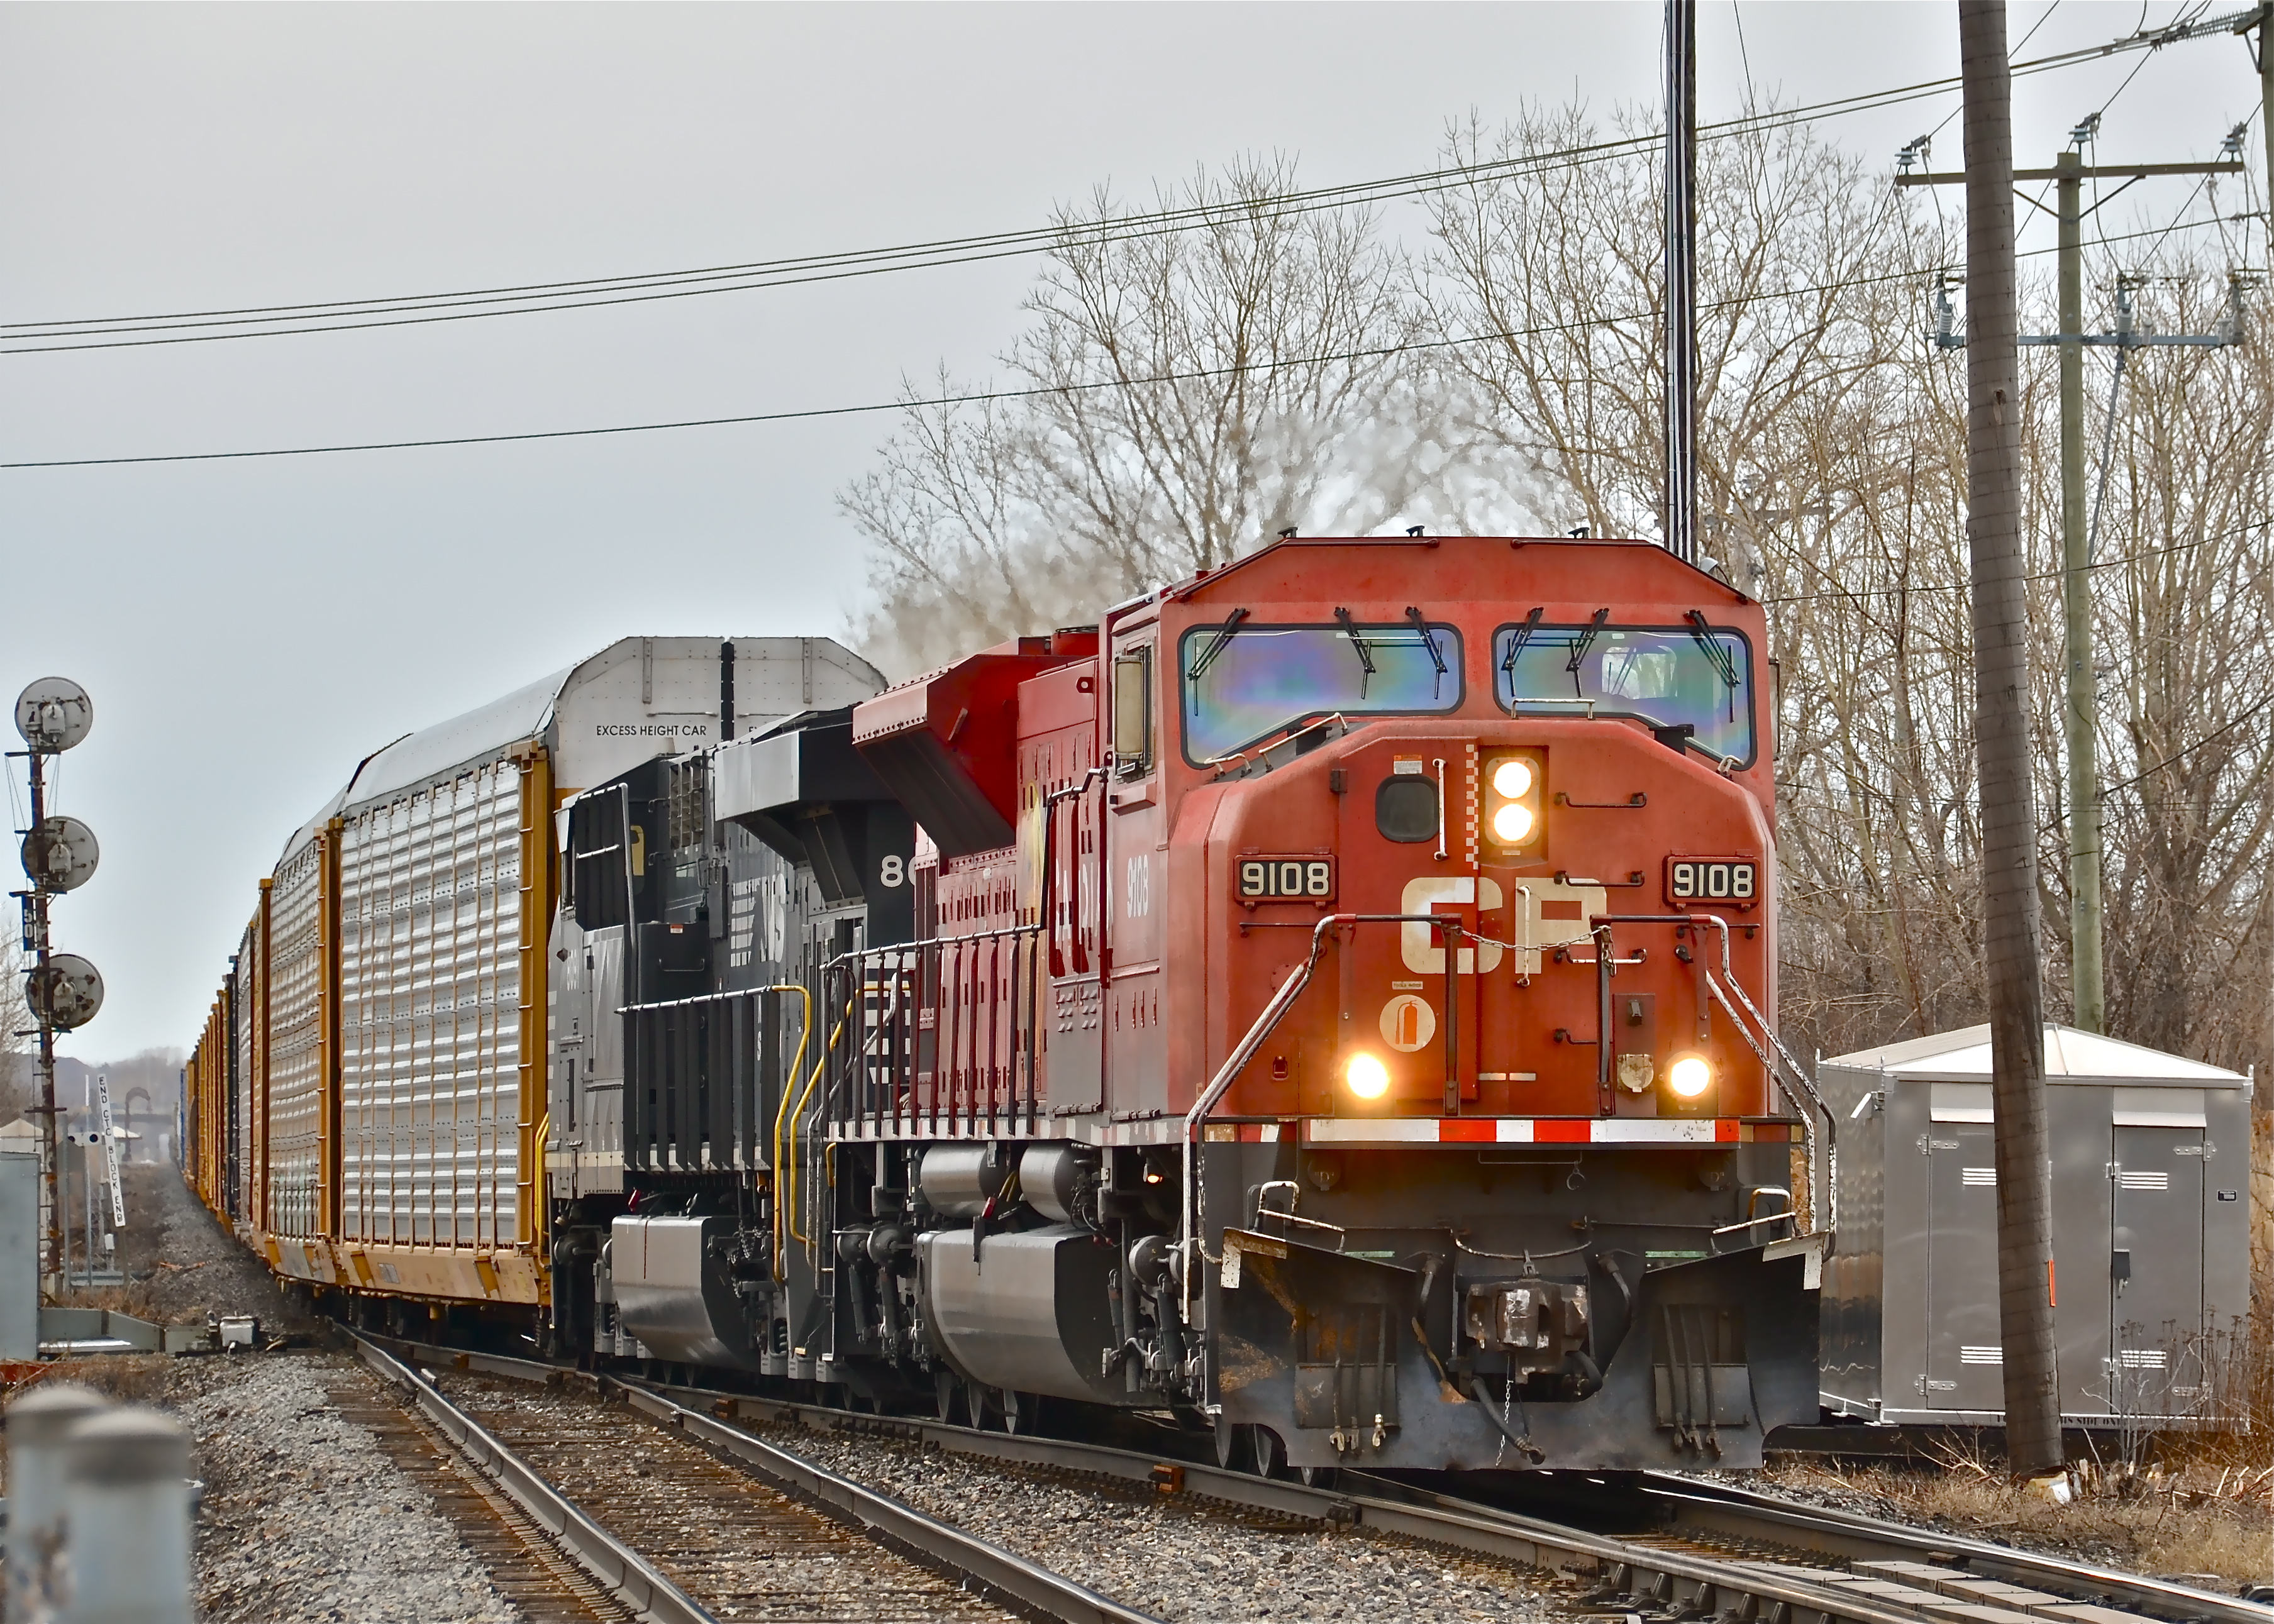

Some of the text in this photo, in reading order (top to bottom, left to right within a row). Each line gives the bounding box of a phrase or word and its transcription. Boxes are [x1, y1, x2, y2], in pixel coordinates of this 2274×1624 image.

[597, 726, 706, 736] EXCESS HEIGHT CAR
[1127, 854, 1148, 919] 9108
[1243, 863, 1329, 895] 9108
[1674, 864, 1753, 897] 9108
[1401, 877, 1607, 974] CP
[99, 1076, 123, 1222] END CTC BLOCK END
